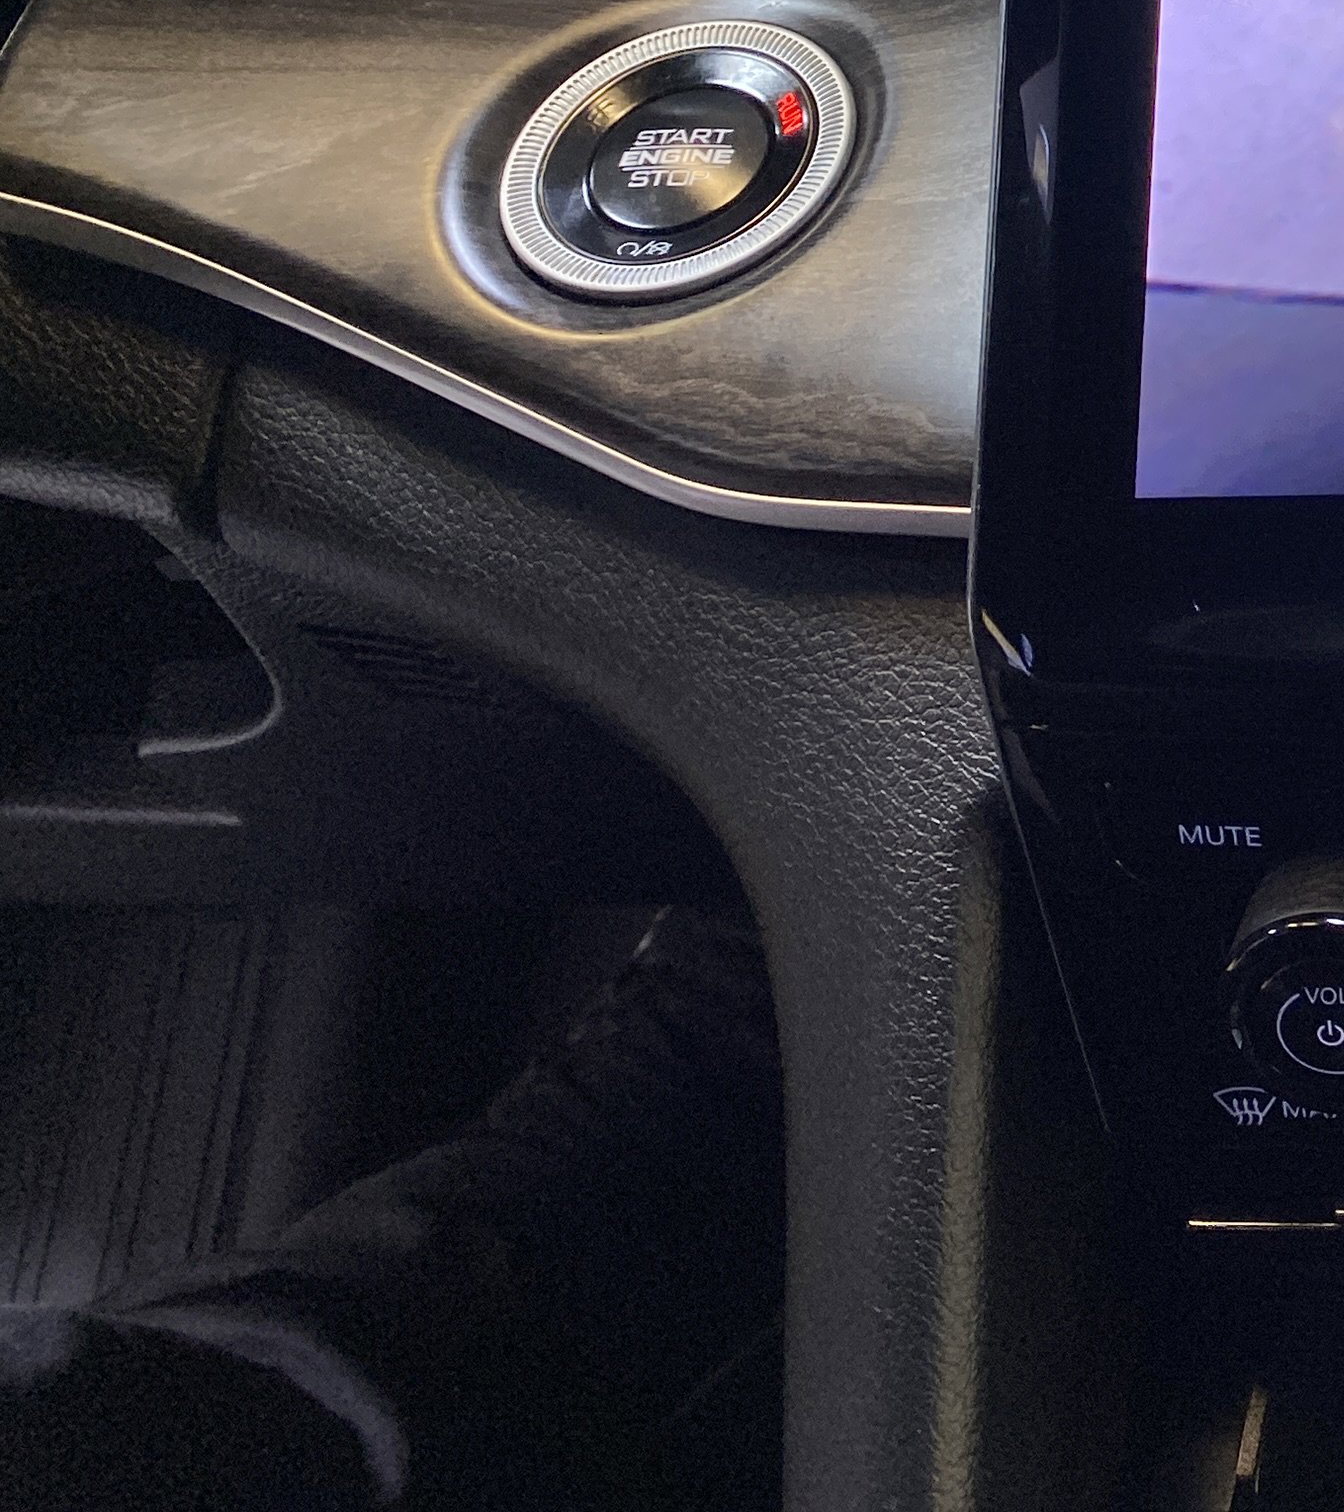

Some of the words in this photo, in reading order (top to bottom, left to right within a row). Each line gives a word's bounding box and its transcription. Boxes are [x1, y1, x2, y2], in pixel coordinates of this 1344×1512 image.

[776, 91, 803, 135] RUN
[634, 128, 734, 145] START
[619, 148, 735, 167] ENGINE
[627, 169, 710, 187] STOP
[1178, 824, 1263, 849] MUTE
